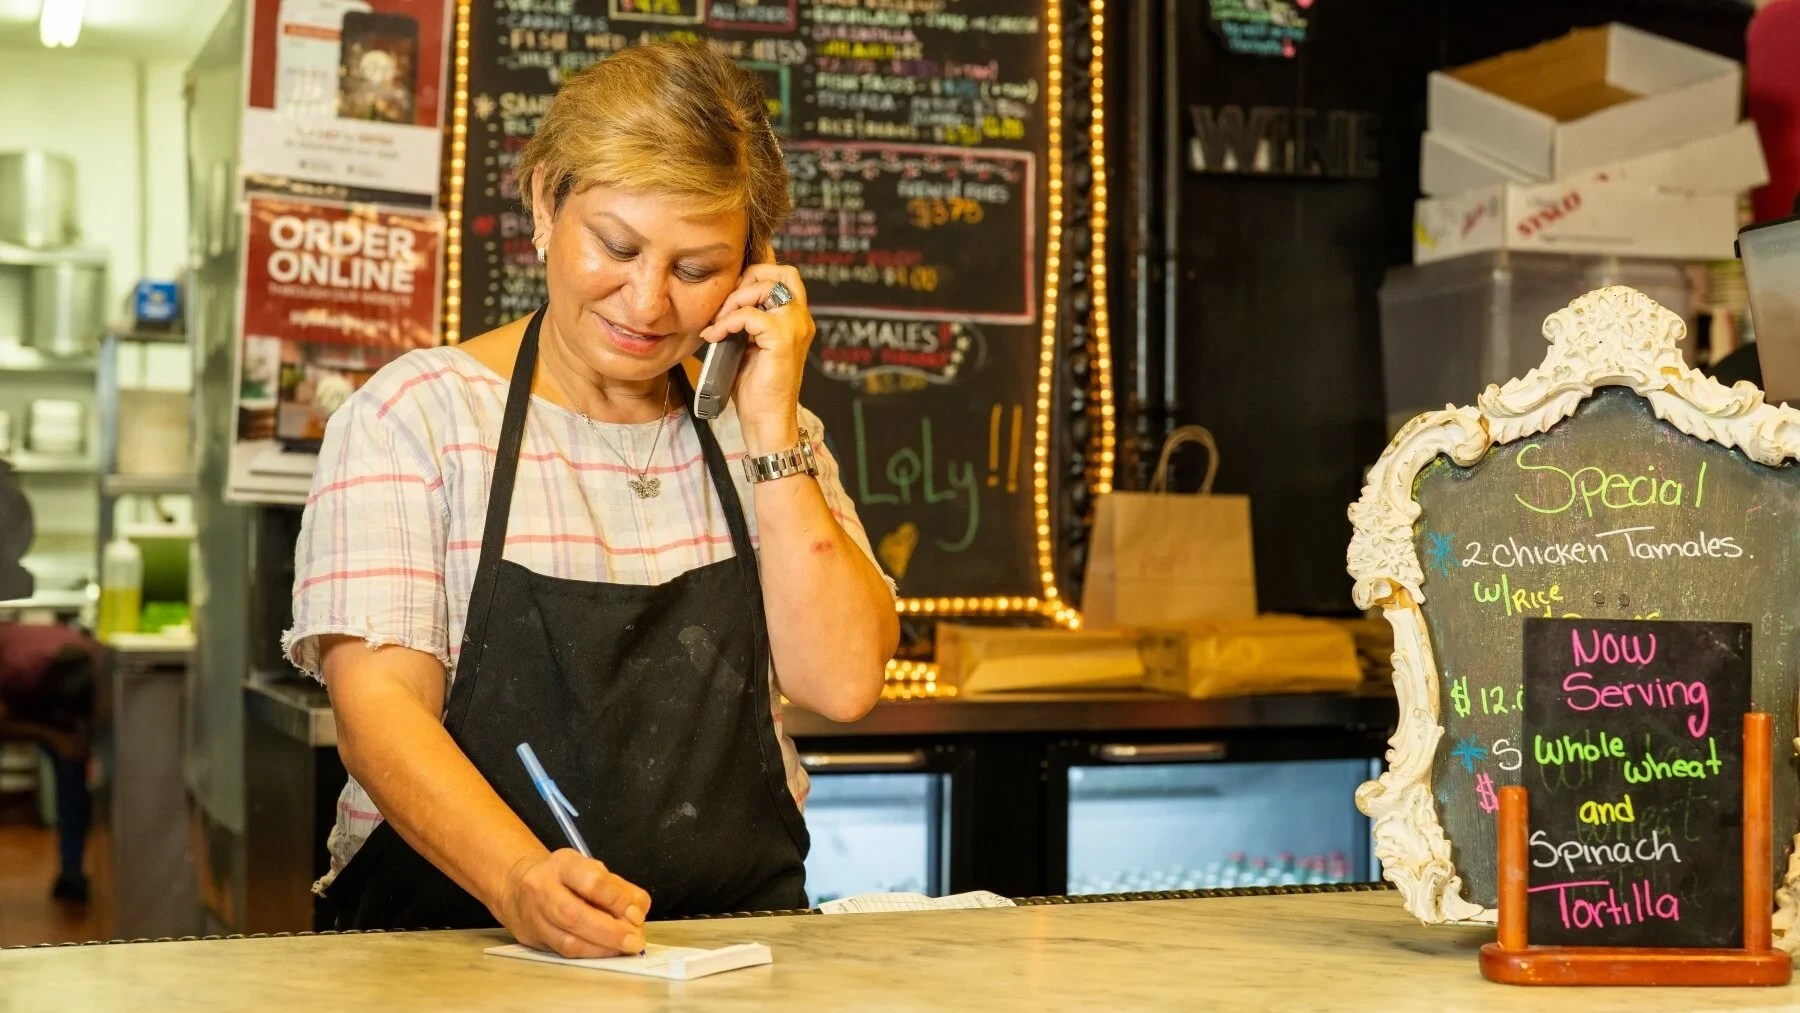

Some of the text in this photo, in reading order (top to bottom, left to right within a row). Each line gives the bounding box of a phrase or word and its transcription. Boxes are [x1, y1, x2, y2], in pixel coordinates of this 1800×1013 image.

[1189, 104, 1382, 177] WINE
[269, 215, 416, 262] ORDER
[267, 250, 415, 294] ONLINE
[1515, 444, 1707, 518] Special
[1462, 541, 1489, 567] 2
[1562, 672, 1710, 738] Serving
[1579, 793, 1635, 825] and
[1529, 830, 1682, 874] Spinach
[1527, 879, 1680, 930] Tortilla
